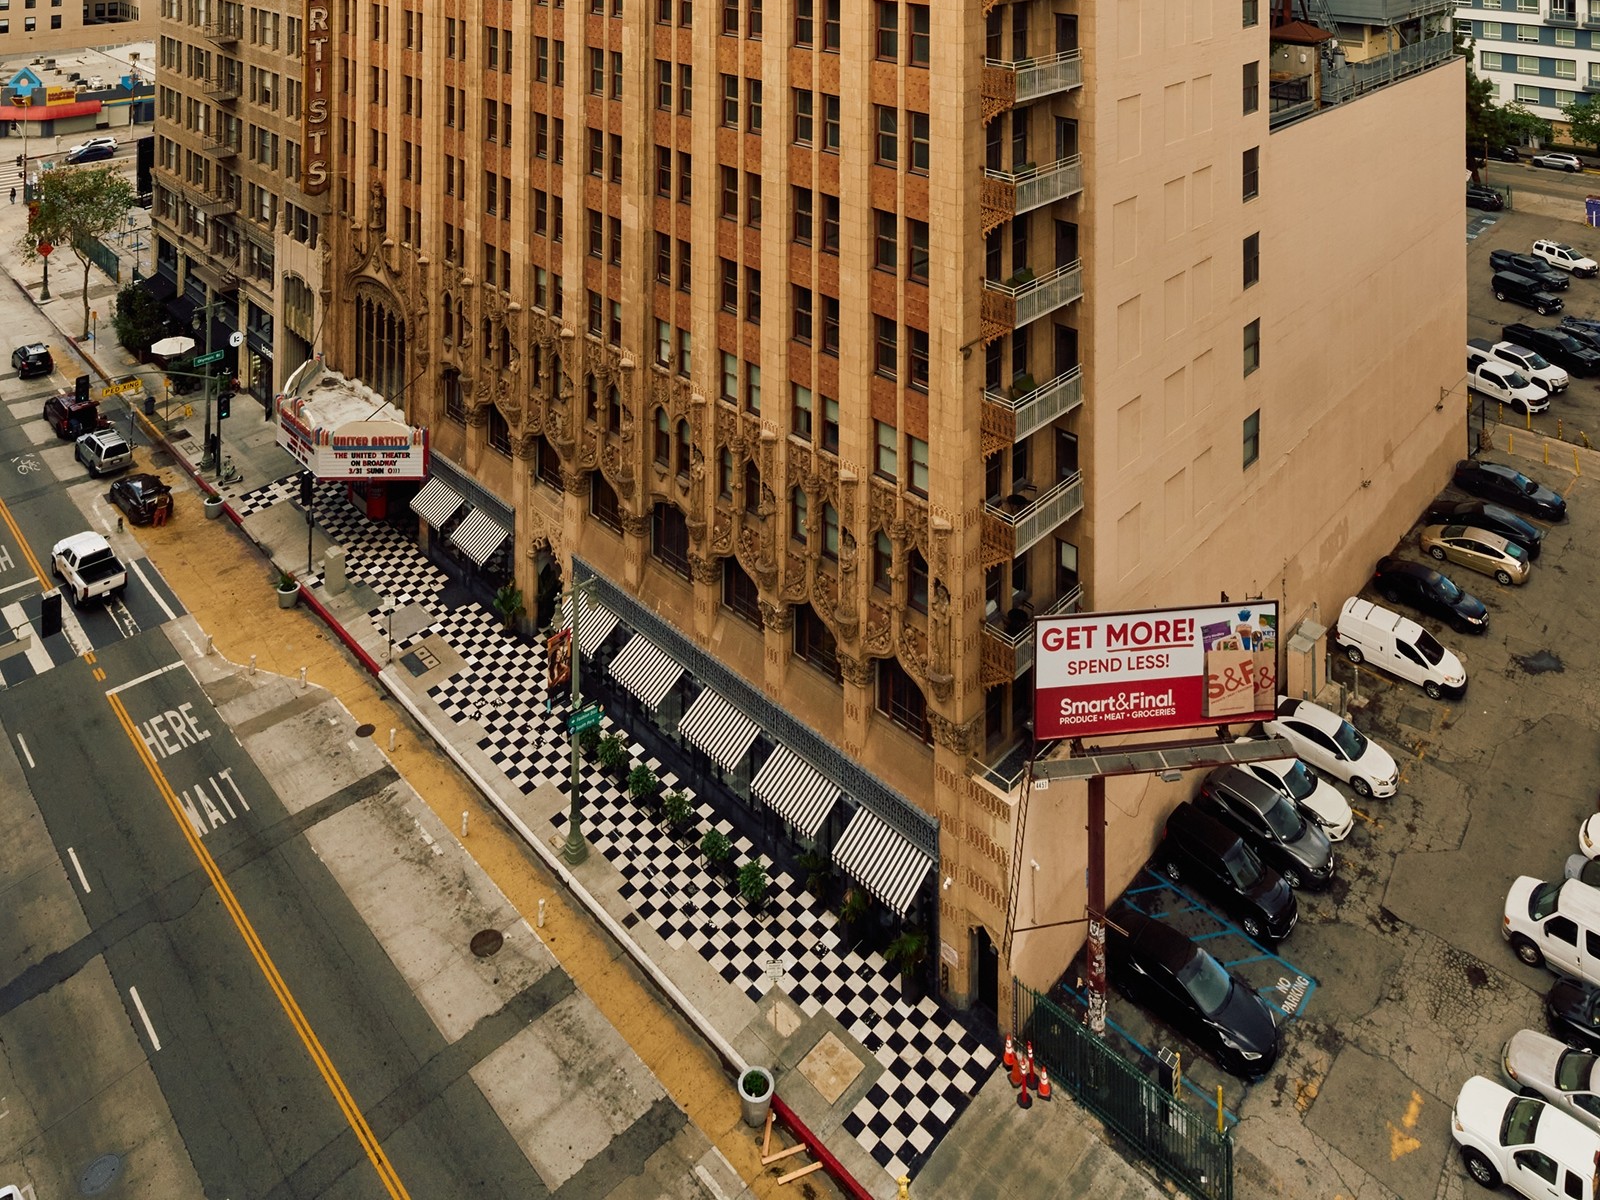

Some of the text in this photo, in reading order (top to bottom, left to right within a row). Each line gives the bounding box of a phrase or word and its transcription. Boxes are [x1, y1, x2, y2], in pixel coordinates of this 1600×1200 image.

[105, 381, 139, 395] PED XING
[333, 436, 408, 446] UNITED ARTISTS
[1041, 617, 1195, 652] GET MORE!
[1067, 654, 1170, 676] SPEND LESS!
[1059, 708, 1176, 725] PRODUCE MEAT GROCERIES
[136, 702, 211, 762] HERE
[177, 767, 250, 837] WAIT
[1275, 977, 1291, 994] NO
[1281, 976, 1309, 1014] PARKING
